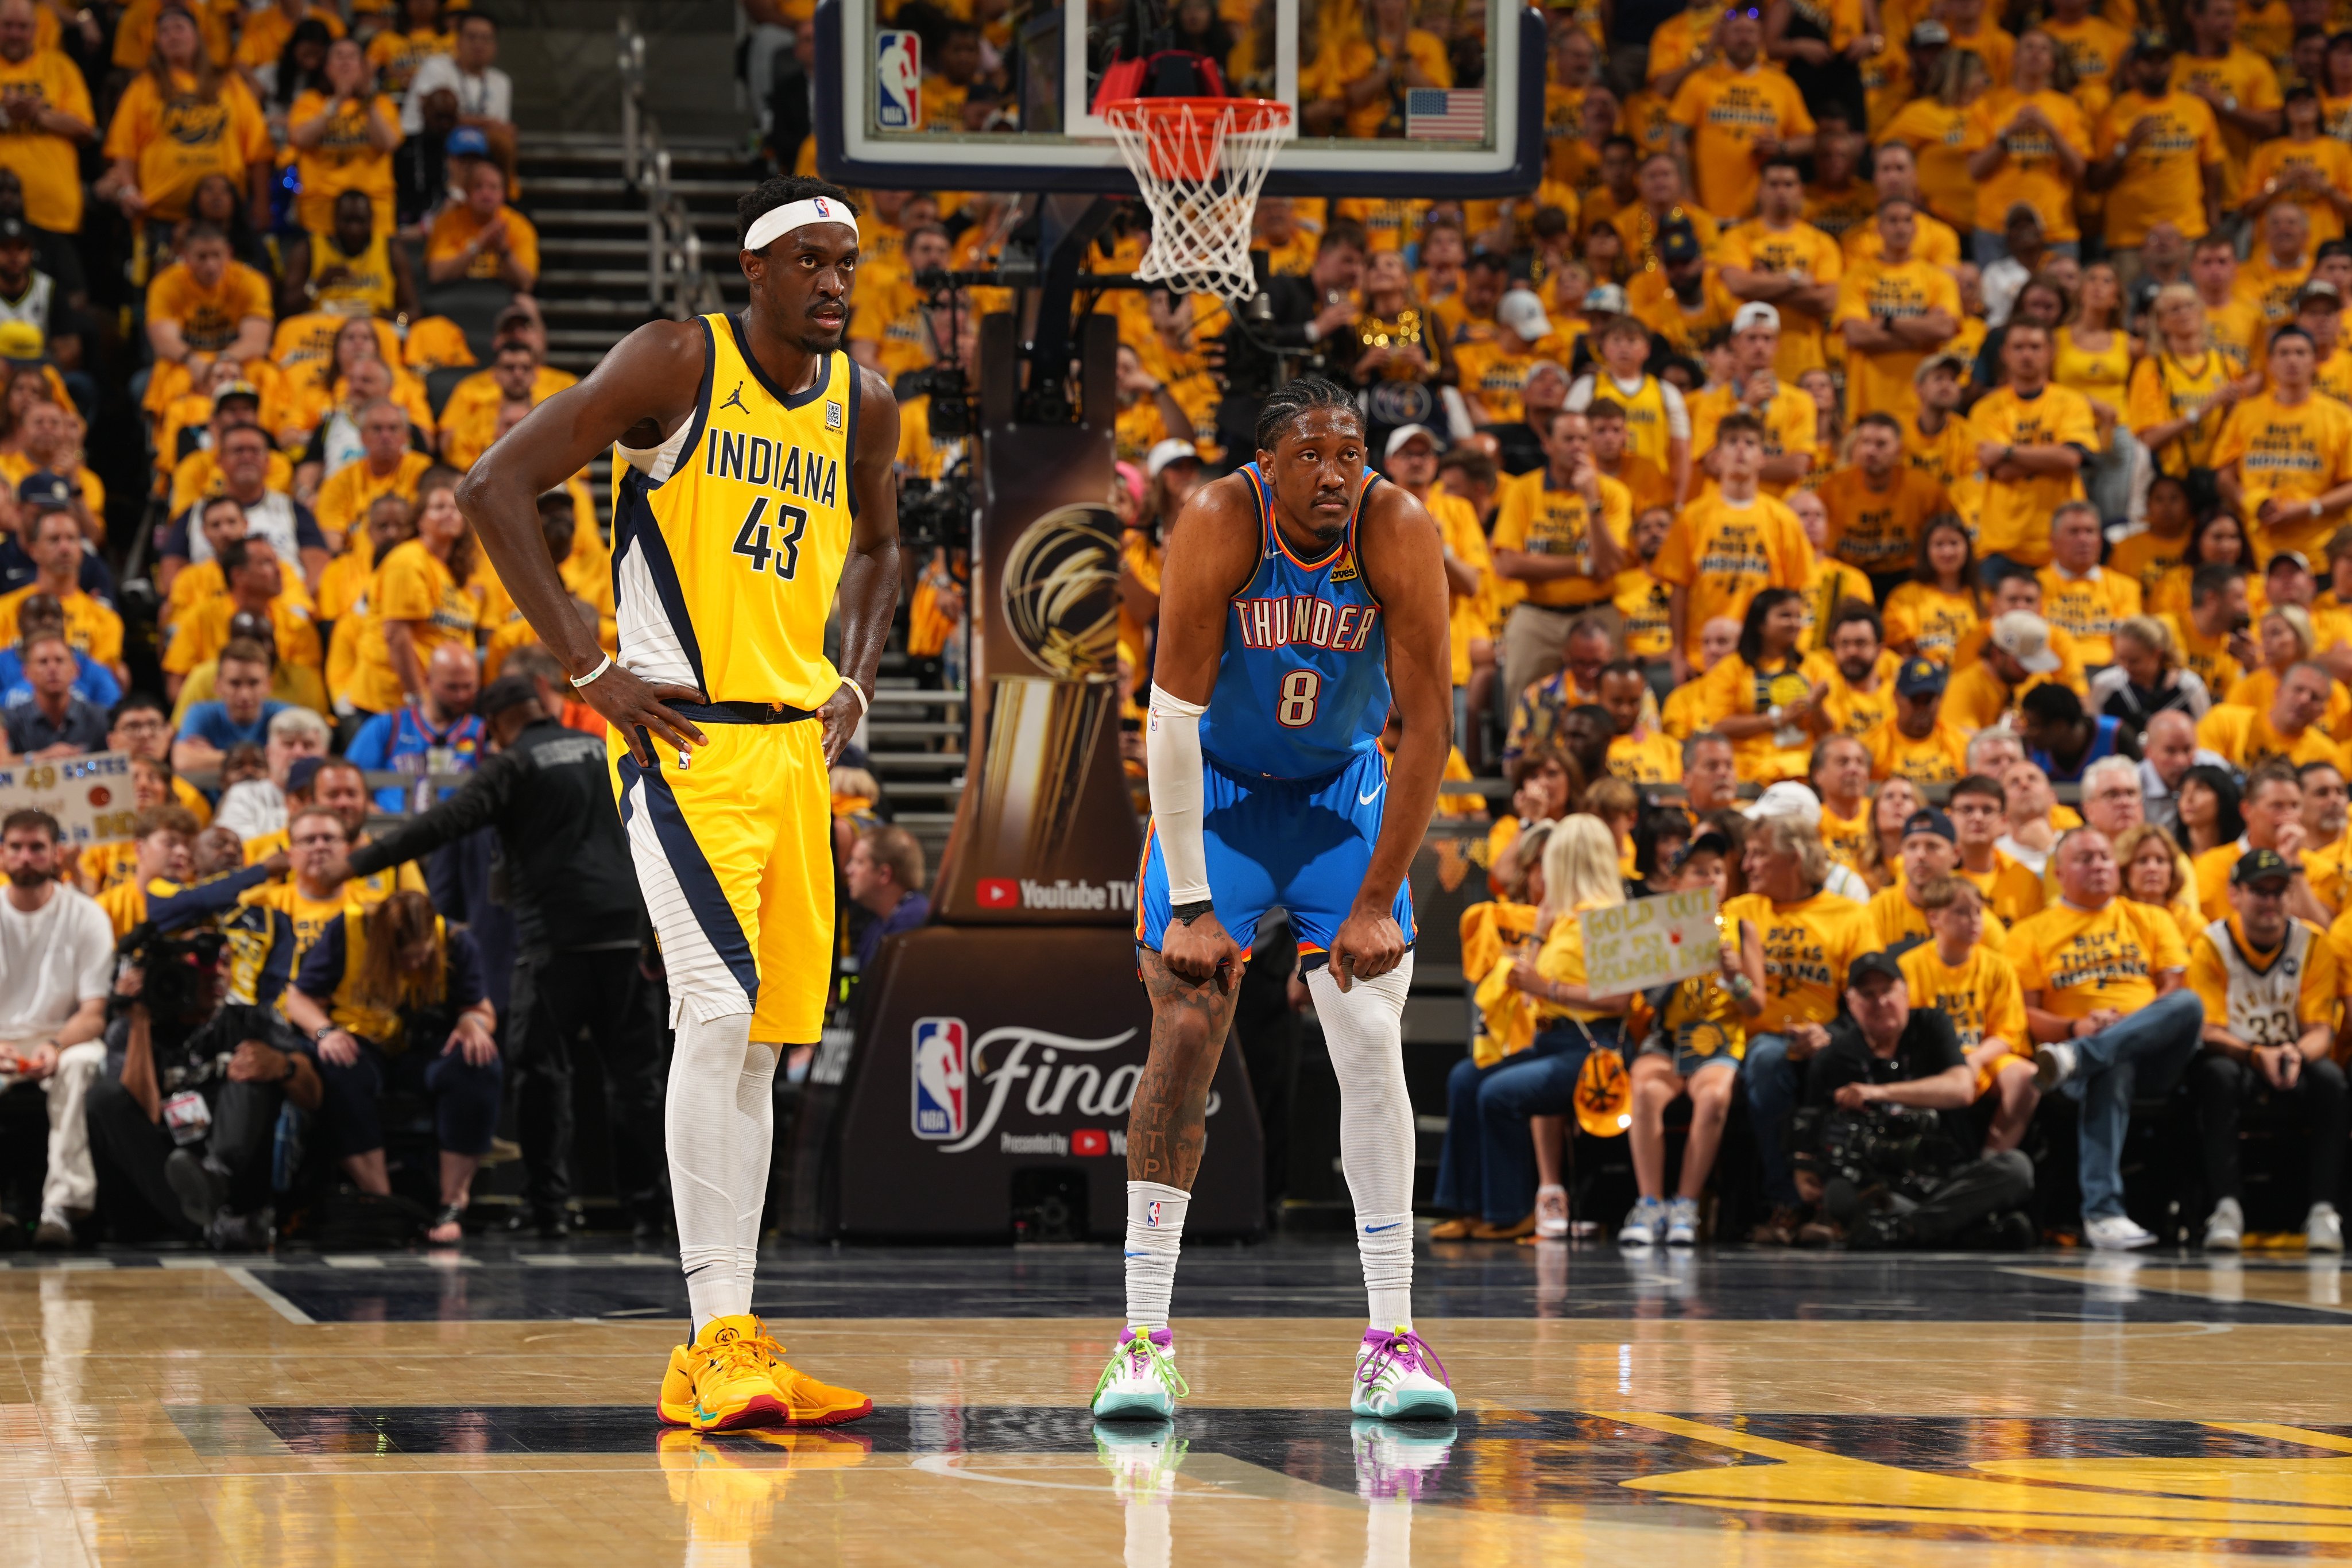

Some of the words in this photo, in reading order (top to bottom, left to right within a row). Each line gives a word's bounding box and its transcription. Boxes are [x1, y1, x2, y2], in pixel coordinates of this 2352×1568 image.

[882, 106, 903, 123] NBA
[825, 425, 844, 435] spokenote
[706, 427, 837, 510] INDIANA
[732, 495, 808, 582] 43
[1231, 595, 1379, 652] THUNDER
[1276, 668, 1321, 729] 8
[24, 765, 56, 792] 49
[1019, 878, 1107, 911] YouTube
[1106, 880, 1136, 911] TV
[1587, 901, 1654, 938] GOLD
[1667, 887, 1711, 919] OUT
[2075, 931, 2117, 948] BUT
[936, 1025, 1221, 1153] Fina
[920, 1110, 947, 1130] NBA
[1001, 1132, 1053, 1153] Presented
